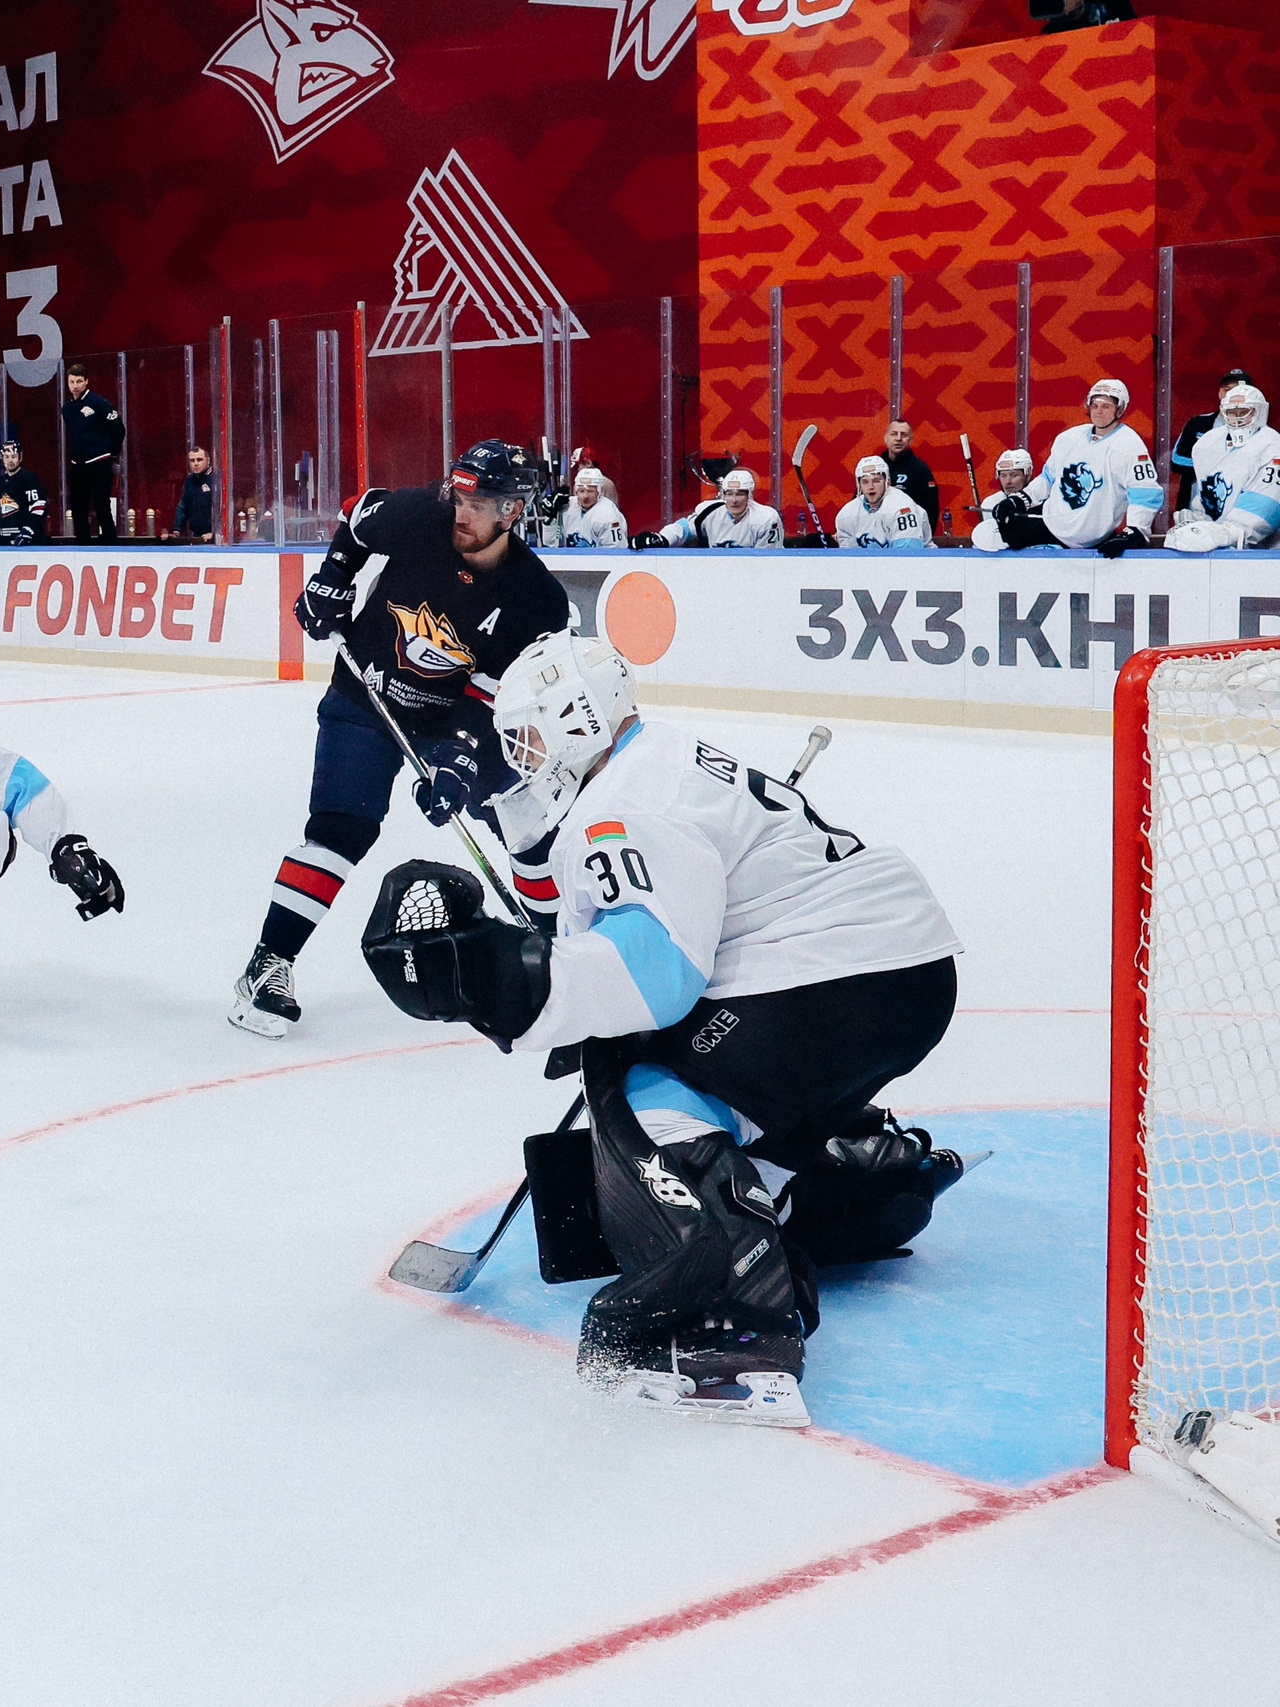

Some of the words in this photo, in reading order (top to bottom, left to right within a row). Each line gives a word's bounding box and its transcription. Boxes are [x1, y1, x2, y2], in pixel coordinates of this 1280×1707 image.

[1133, 463, 1155, 481] 86
[897, 514, 918, 532] 88
[2, 563, 244, 643] FONBET
[306, 581, 355, 601] BAUE
[477, 607, 501, 636] A
[584, 847, 654, 904] 30
